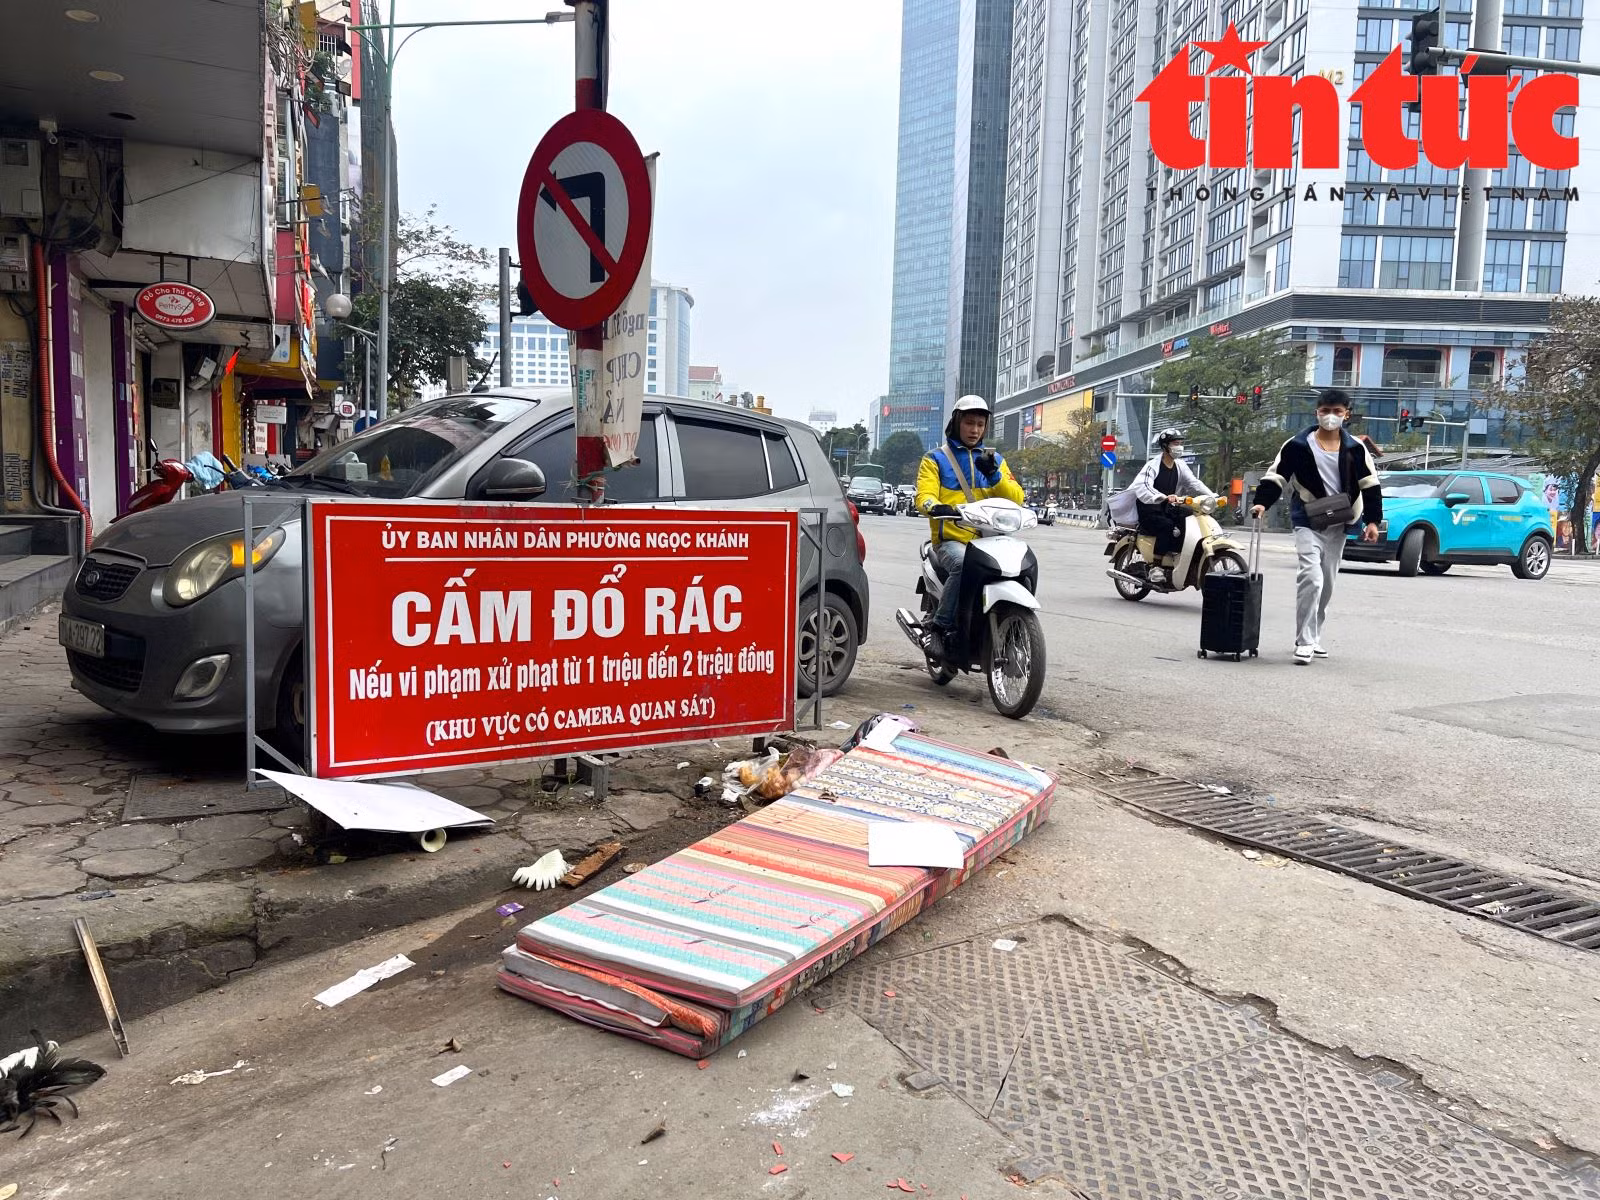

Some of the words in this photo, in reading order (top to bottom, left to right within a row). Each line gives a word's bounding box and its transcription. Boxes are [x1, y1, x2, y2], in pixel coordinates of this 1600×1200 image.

[382, 523, 410, 549] ỦY
[417, 531, 458, 549] BAN
[464, 528, 518, 549] NHÂN
[524, 527, 560, 549] DÂN
[567, 527, 641, 549] PHƯỜNG
[646, 532, 692, 552] NGỌC
[696, 529, 749, 549] KHÁNH
[392, 568, 532, 646] CẤM
[551, 564, 627, 640] ĐỔ
[644, 575, 742, 636] RÁC
[350, 660, 392, 700] Nếu
[399, 666, 417, 697] vi
[424, 664, 481, 699] phạm
[488, 657, 513, 691] xử
[517, 659, 559, 692] phạt
[563, 655, 582, 686] từ
[586, 656, 595, 683] 1
[602, 652, 642, 687] triệu
[647, 645, 678, 680] đến
[682, 651, 693, 677] 2
[697, 646, 733, 680] triệu
[738, 642, 775, 674] đồng
[426, 717, 476, 746] (KHU
[482, 711, 521, 740] VỰC
[525, 707, 549, 732] CÓ
[553, 704, 626, 729] CAMERA
[629, 700, 676, 726] QUAN
[680, 694, 716, 719] SÁT)
